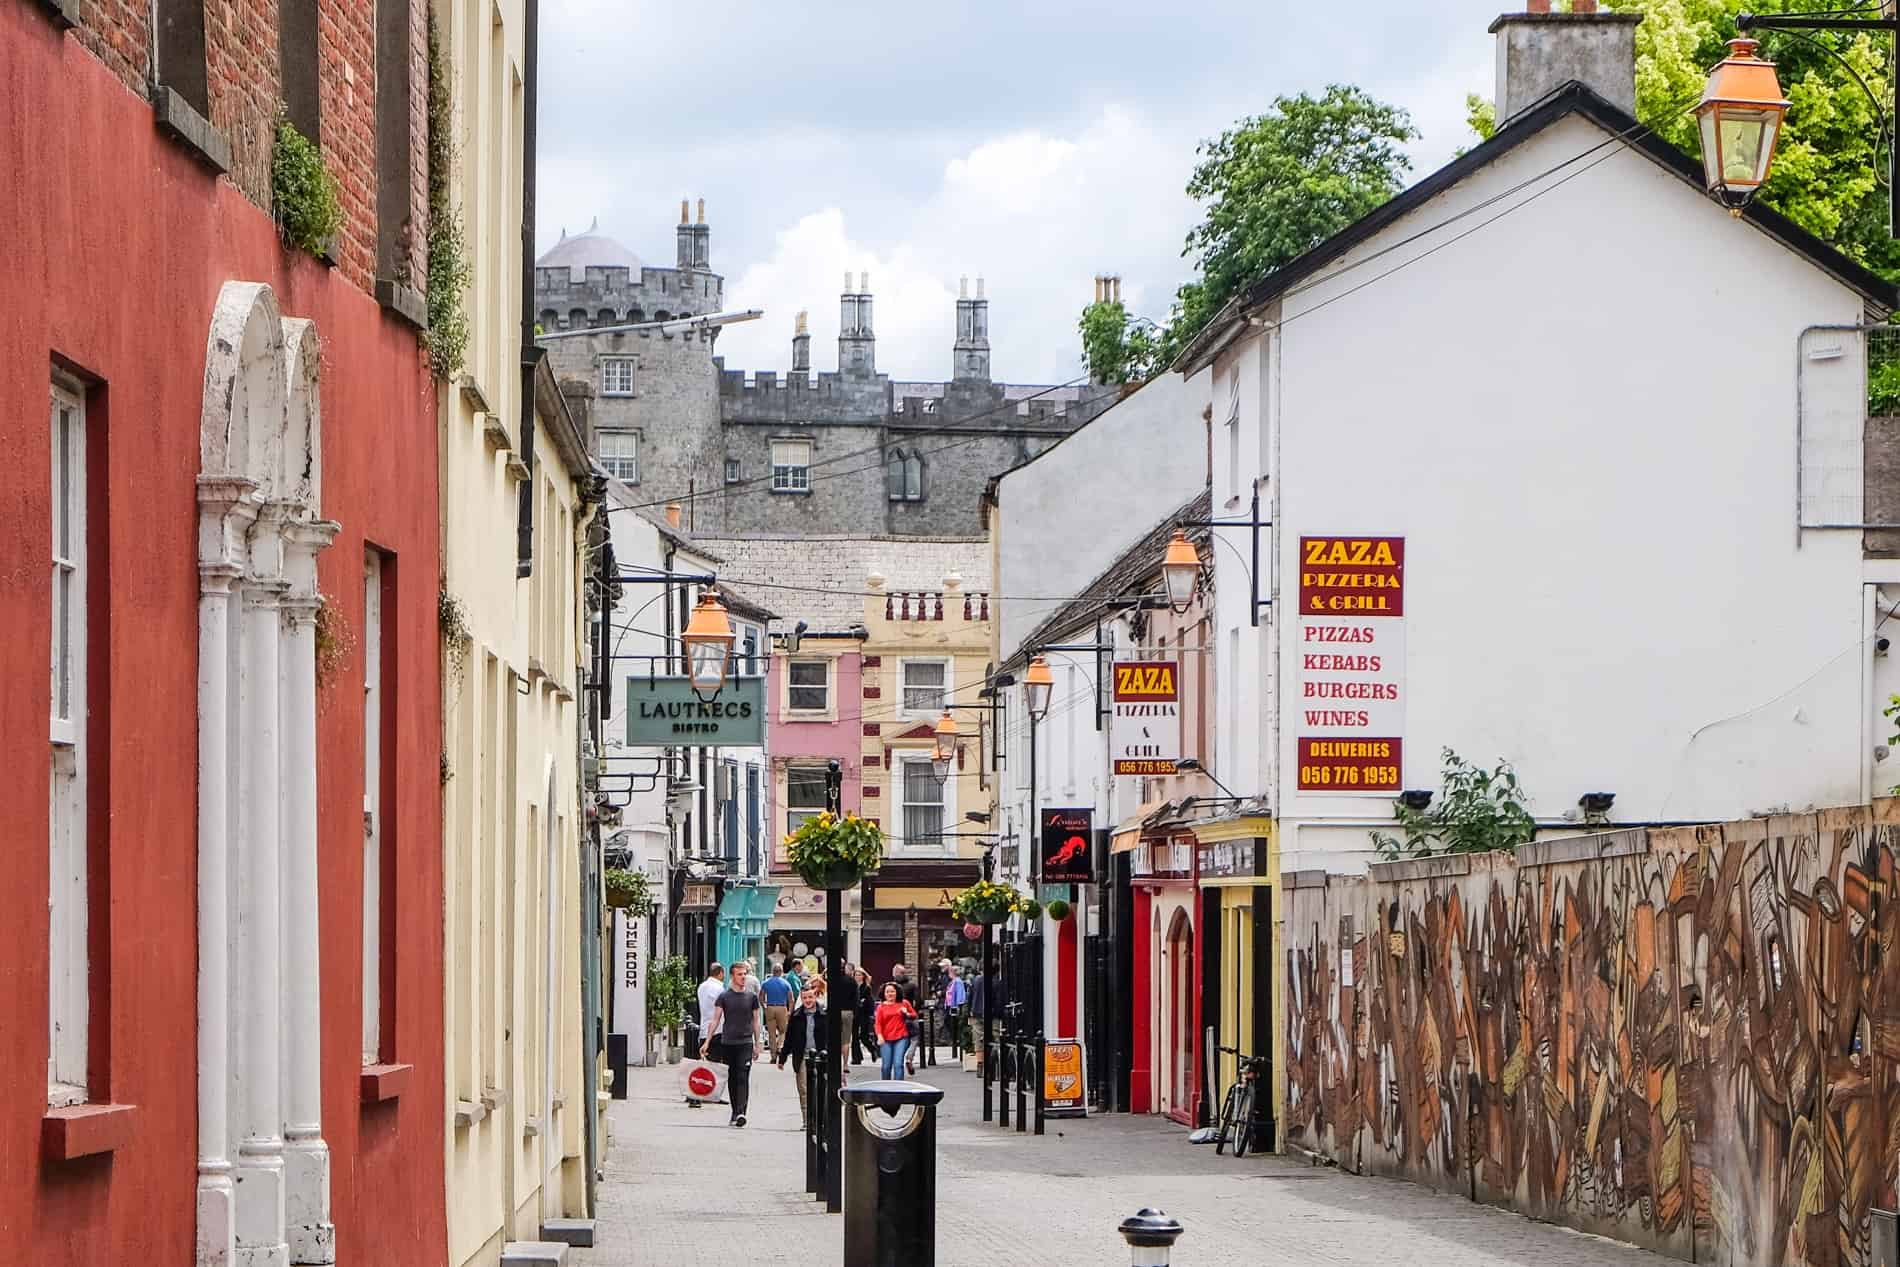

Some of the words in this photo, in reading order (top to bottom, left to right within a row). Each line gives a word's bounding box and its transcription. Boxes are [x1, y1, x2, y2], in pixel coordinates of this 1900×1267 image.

[1306, 541, 1396, 565] ZAZA
[1303, 573, 1400, 588] PIZZERIA
[1310, 595, 1326, 610] &
[1329, 595, 1392, 610] GRILL
[1304, 627, 1374, 643] PIZZAS
[1304, 654, 1381, 672] KEBABS
[1118, 667, 1175, 695] ZAZA
[1304, 682, 1398, 700] BURGERS
[640, 702, 752, 718] LAUTRECS
[1305, 710, 1369, 727] WINES
[672, 723, 720, 733] BISTRO
[1310, 742, 1390, 758] DELIVERIES
[1119, 761, 1136, 773] 056
[1138, 761, 1154, 773] 776
[1302, 766, 1330, 784] 056
[1333, 766, 1359, 784] 776
[1362, 766, 1398, 784] 1953
[625, 951, 638, 989] ROOM
